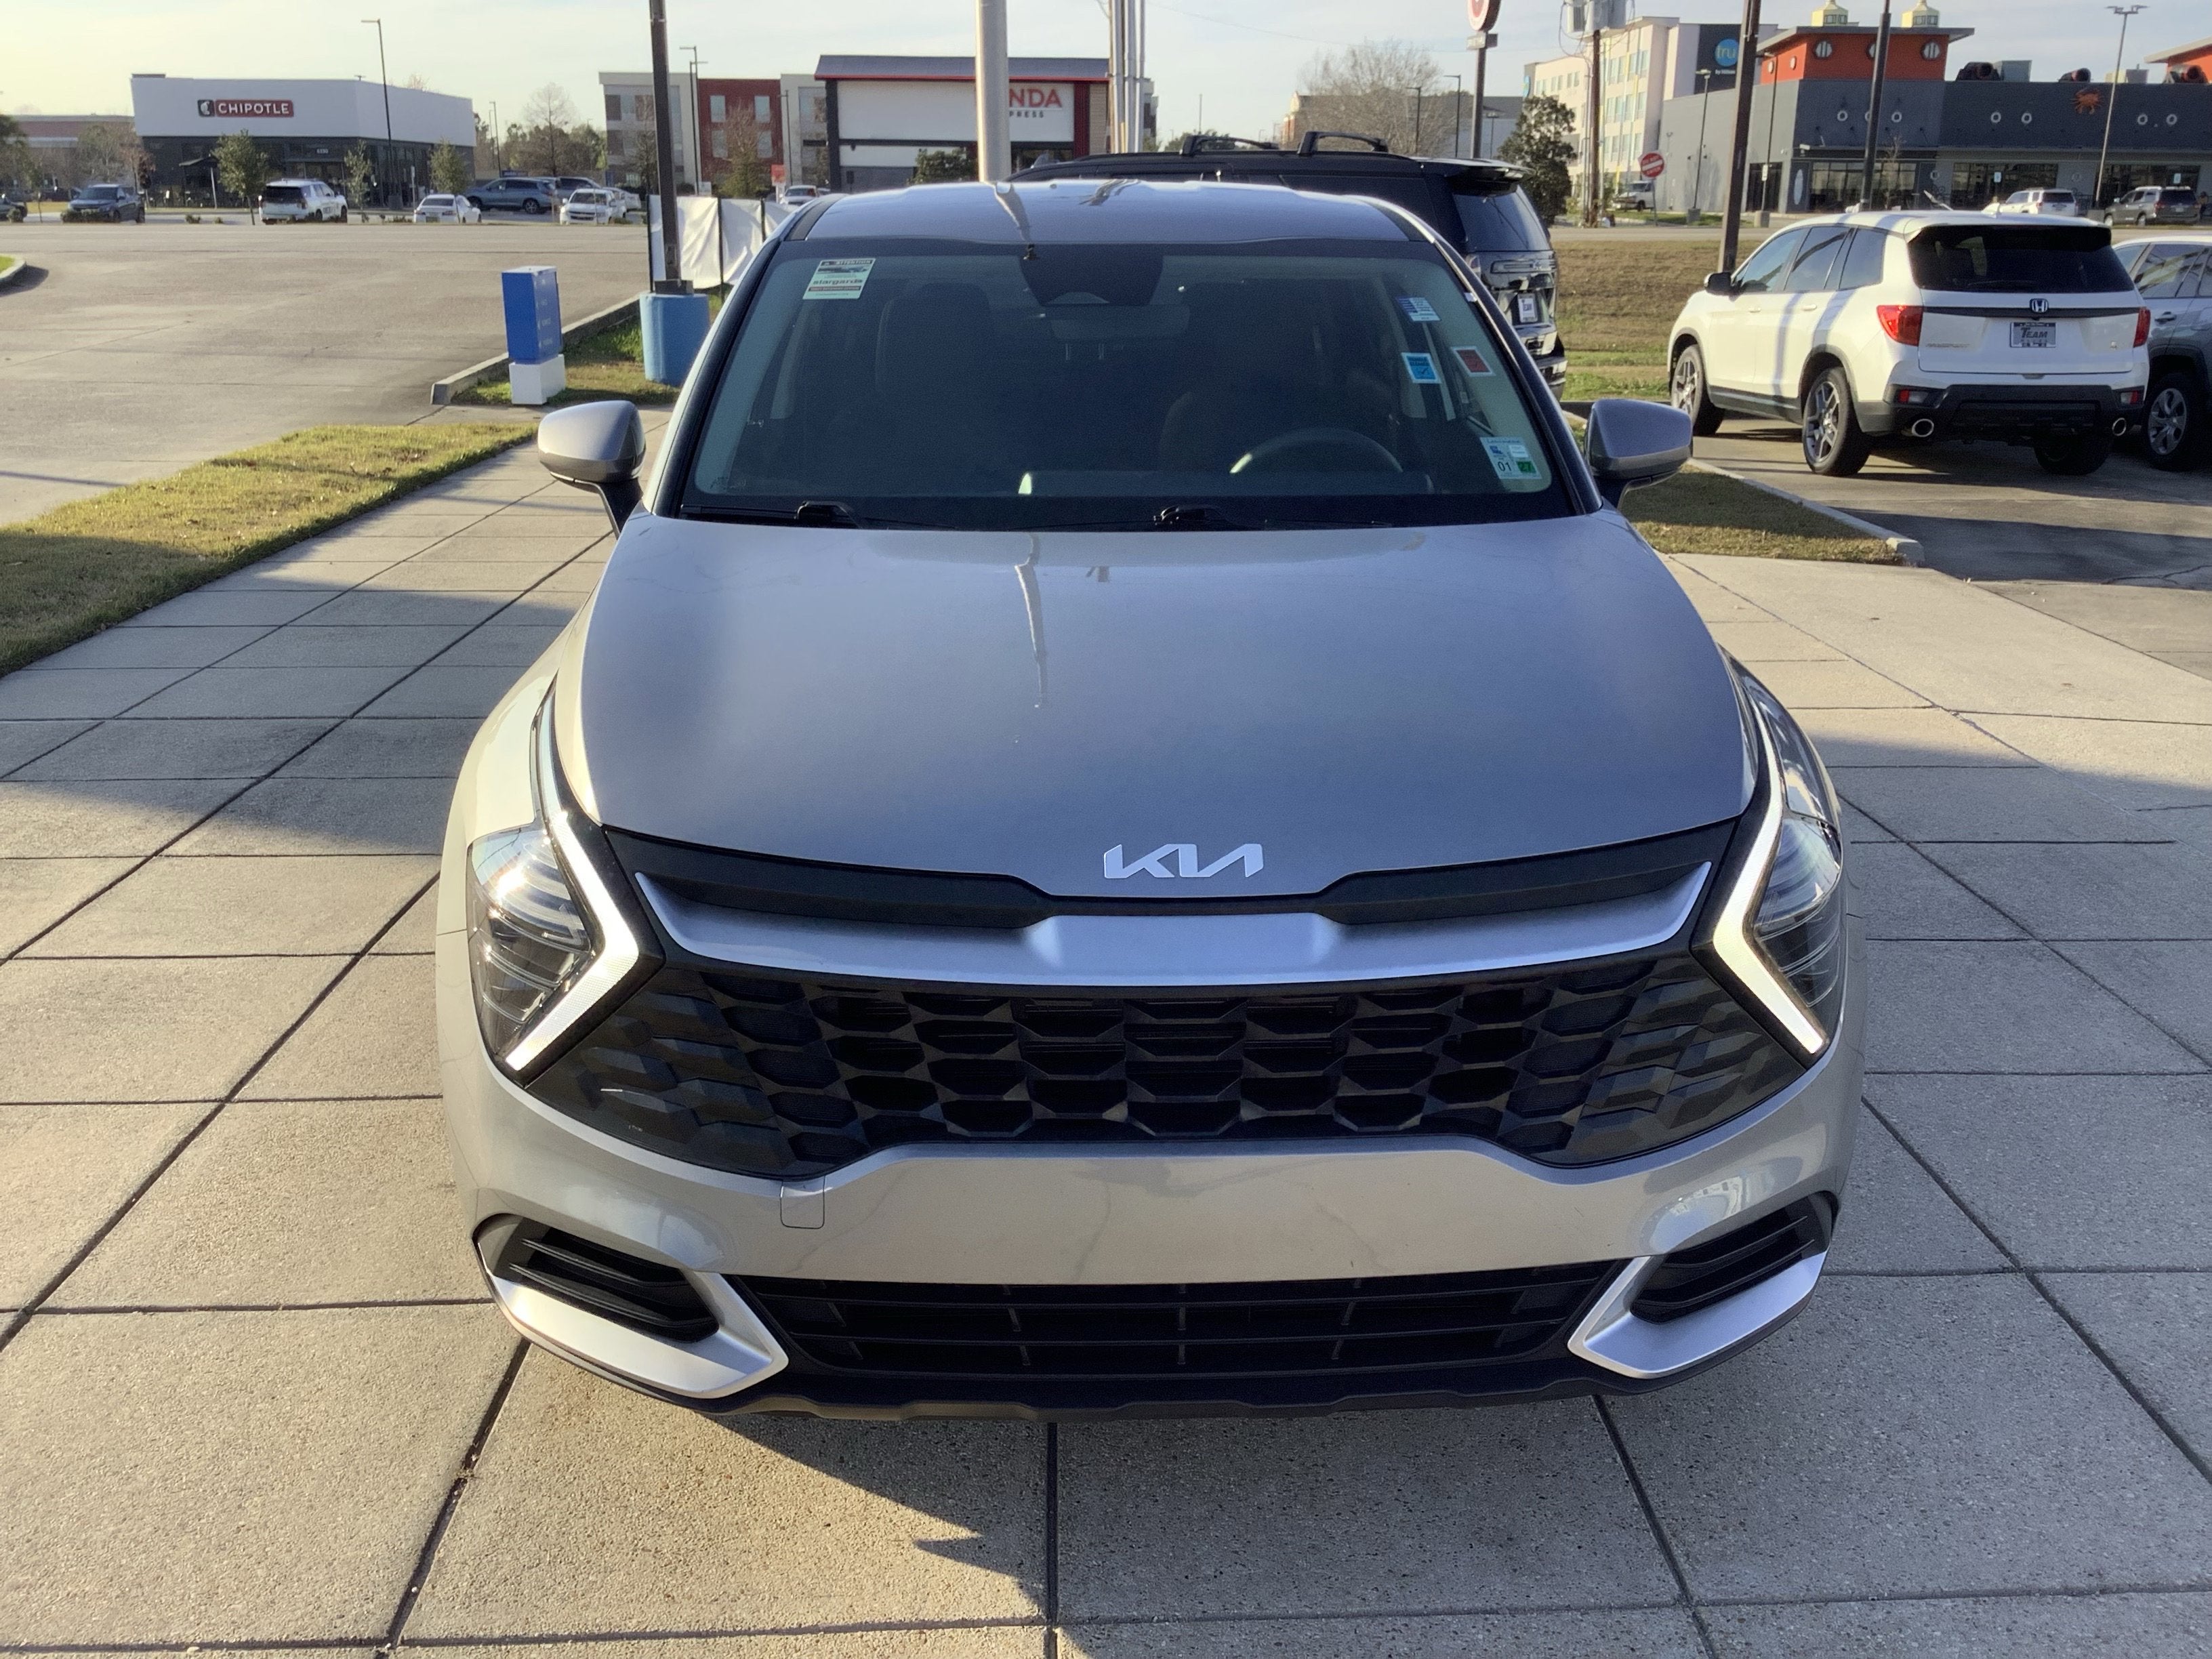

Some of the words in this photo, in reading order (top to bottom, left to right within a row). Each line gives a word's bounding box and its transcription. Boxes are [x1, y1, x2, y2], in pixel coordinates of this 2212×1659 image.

[1008, 88, 1063, 108] NDA
[218, 103, 290, 114] CHIPOTLE
[1008, 110, 1044, 118] PRESS
[1497, 462, 1512, 472] 01
[1517, 462, 1532, 472] 27
[1104, 843, 1264, 879] KIA
